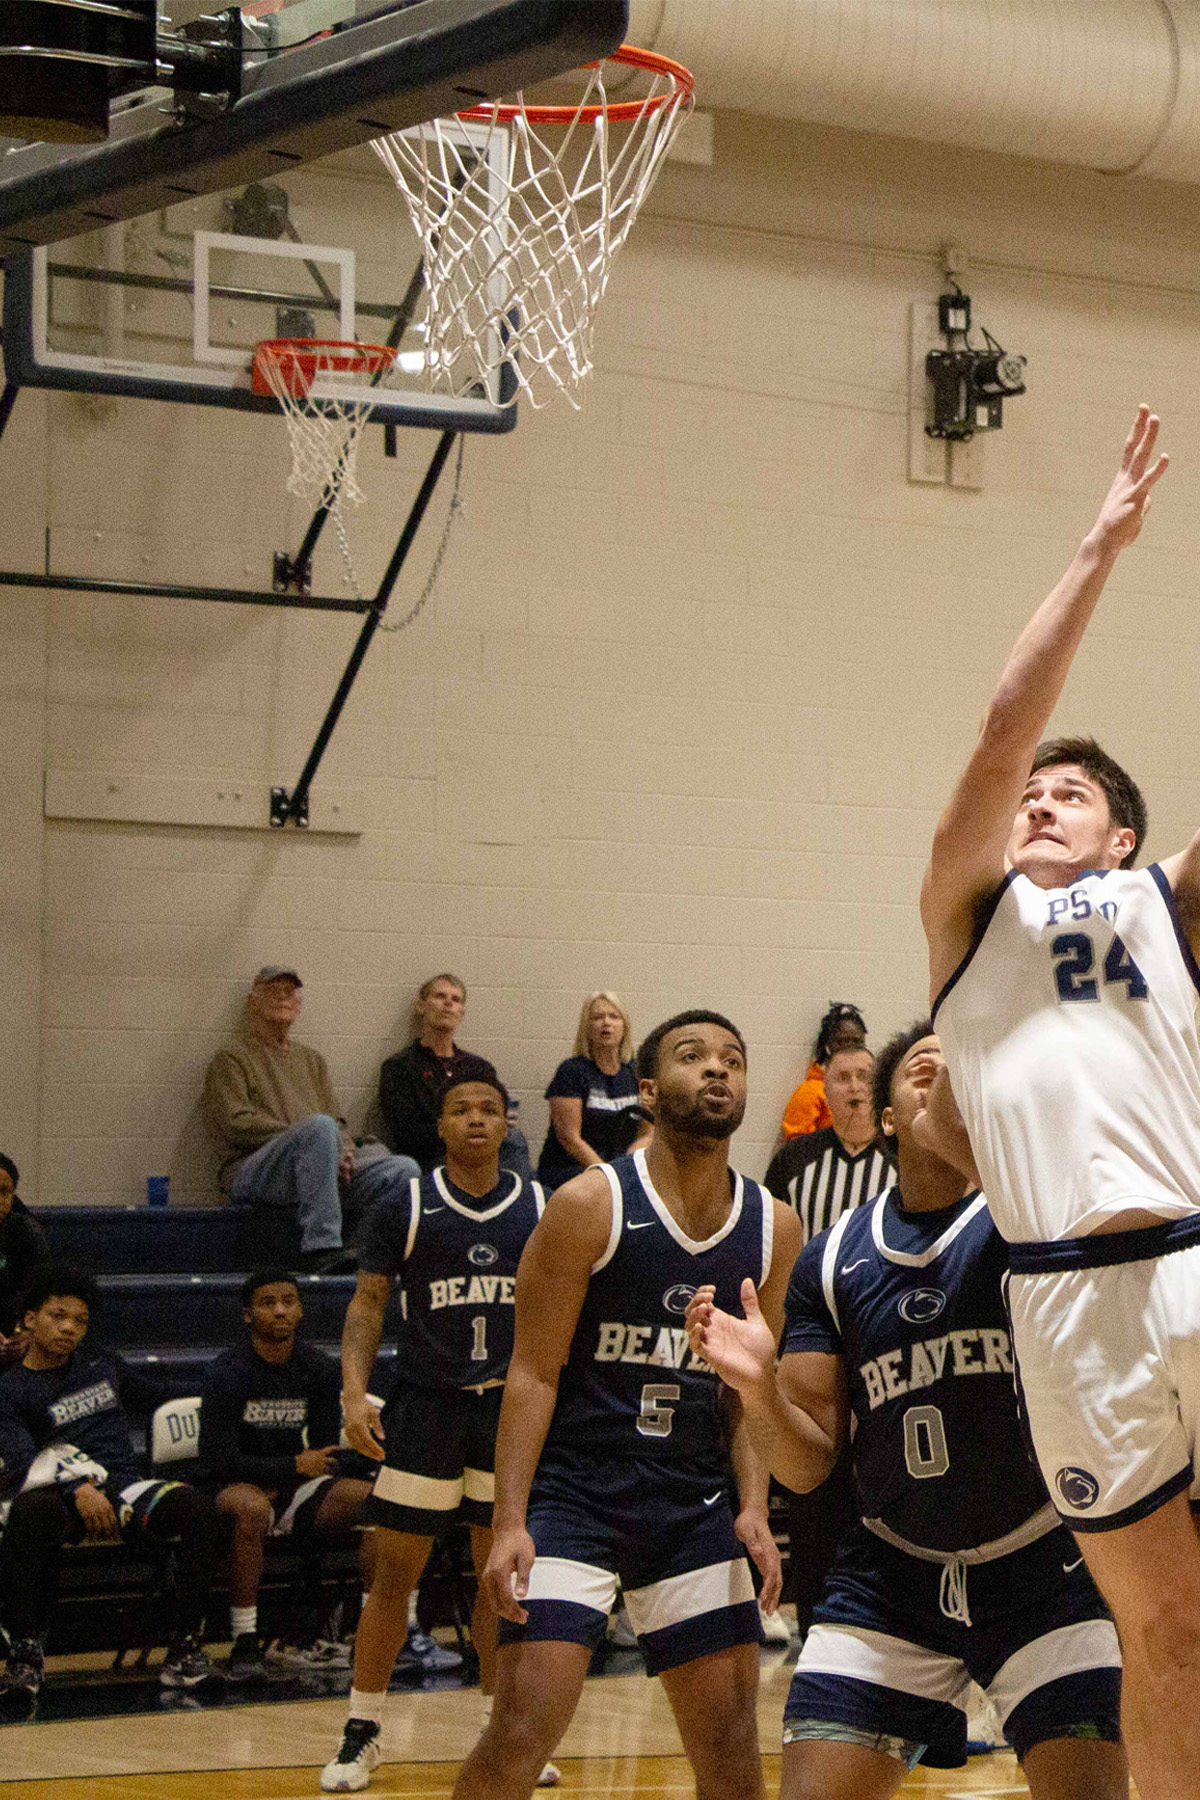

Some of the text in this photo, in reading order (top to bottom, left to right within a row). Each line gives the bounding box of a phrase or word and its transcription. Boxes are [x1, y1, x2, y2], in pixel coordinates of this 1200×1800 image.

[1046, 889, 1118, 927] PSD
[1050, 931, 1150, 1004] 24
[429, 1275, 516, 1310] BEAVE
[471, 1316, 488, 1360] 1
[594, 1322, 715, 1374] BEAV
[859, 1328, 1014, 1411] BEAVER
[636, 1384, 680, 1437] 5
[903, 1405, 950, 1479] 0
